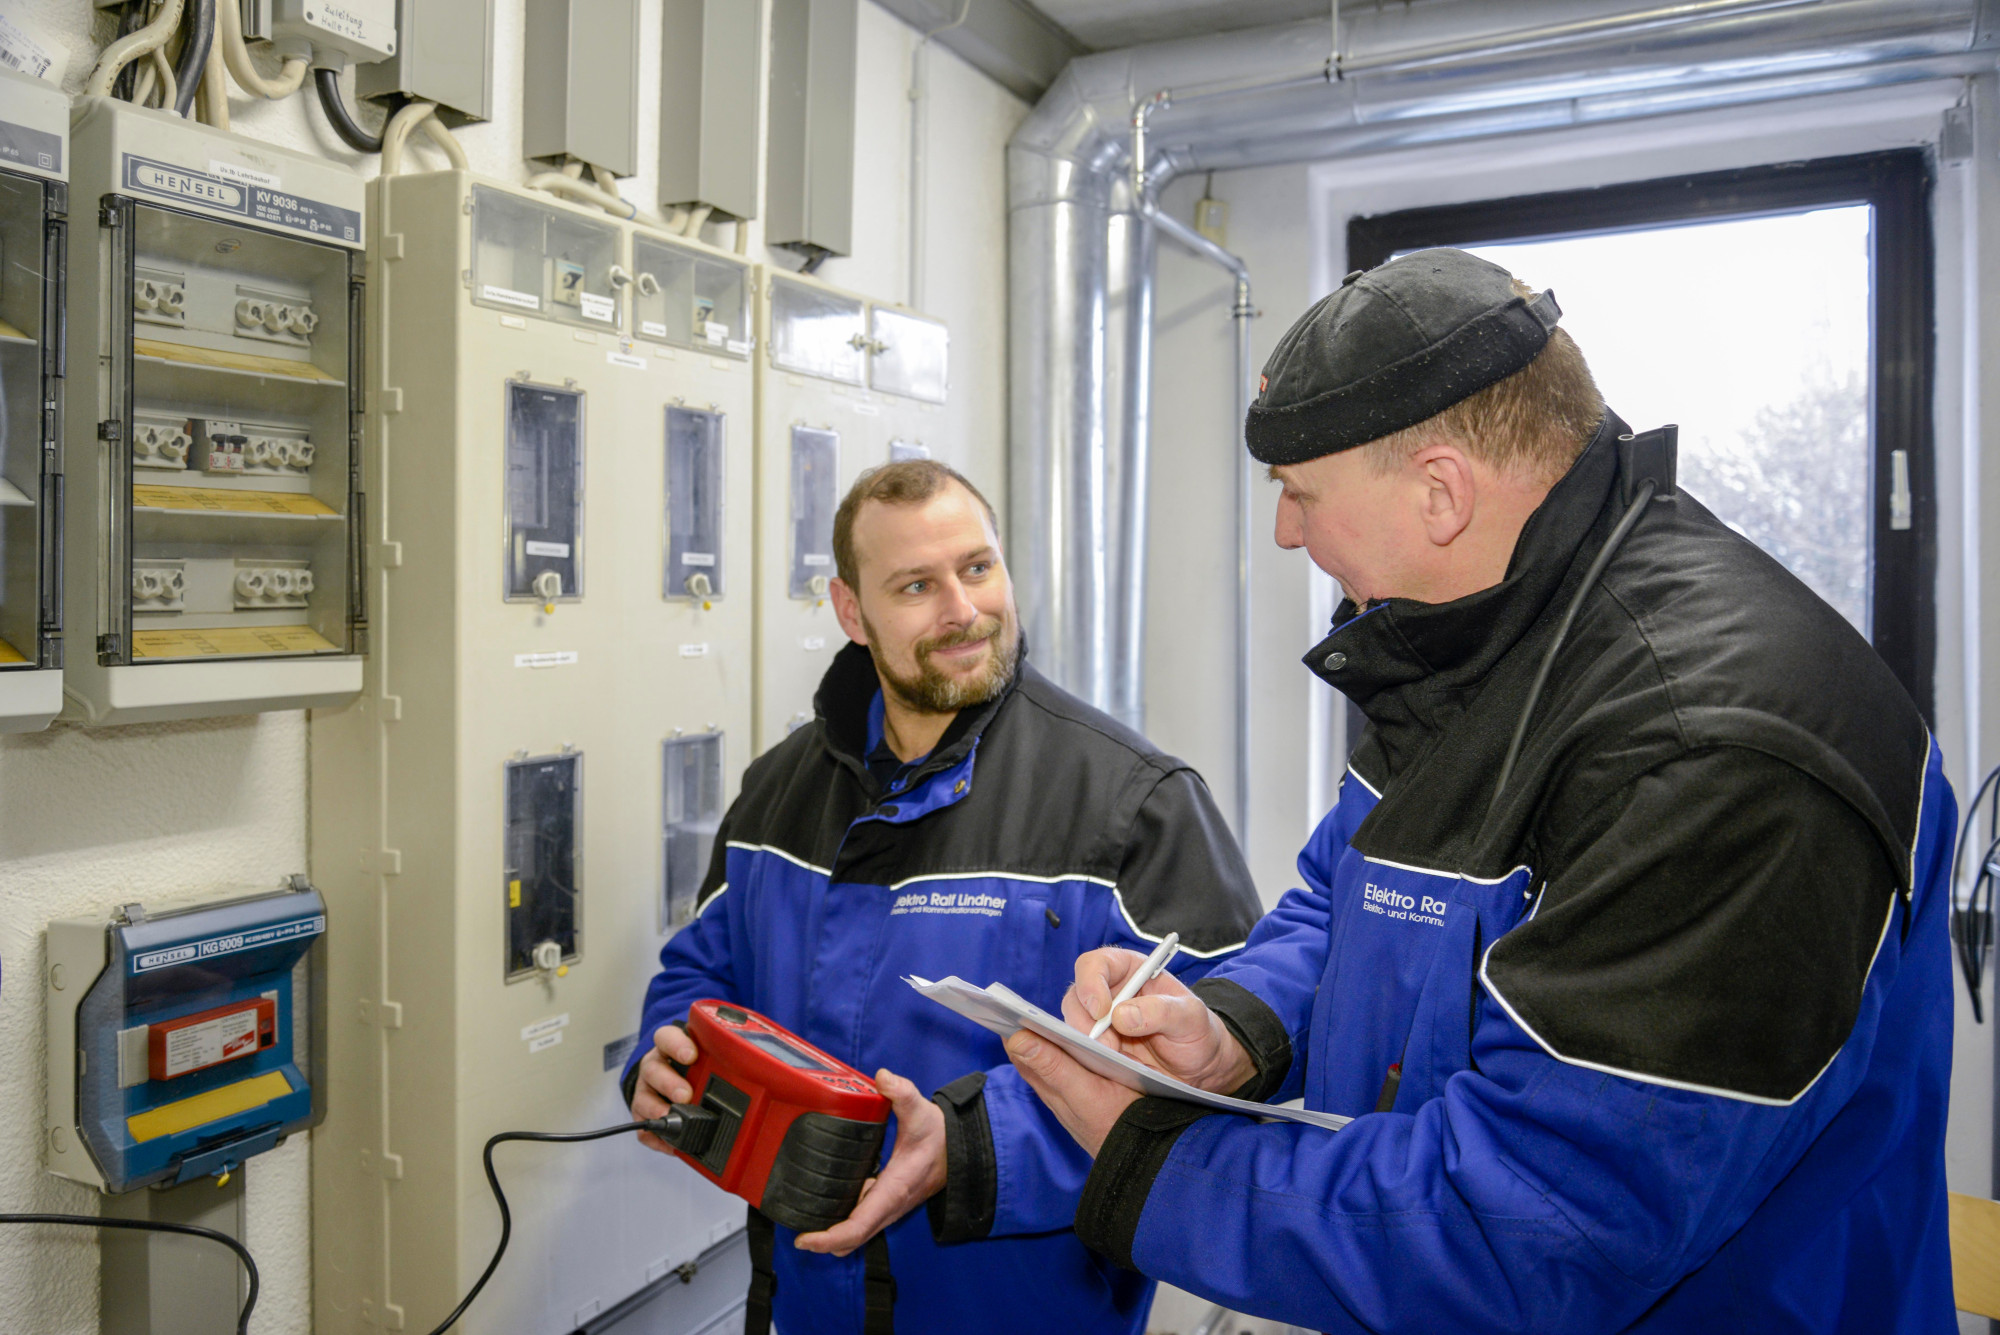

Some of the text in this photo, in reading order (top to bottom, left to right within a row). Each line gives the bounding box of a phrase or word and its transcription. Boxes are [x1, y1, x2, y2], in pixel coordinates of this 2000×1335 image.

[324, 3, 363, 29] Zuleitung
[154, 172, 225, 200] HENSEL
[256, 190, 271, 204] KV
[272, 194, 298, 211] 9036
[930, 891, 956, 907] Ralf
[957, 893, 1007, 909] Lindner
[1363, 901, 1386, 915] Elektro-
[1387, 909, 1408, 920] und
[1364, 882, 1447, 916] Elektro Ra
[148, 950, 187, 964] HENSEL
[202, 941, 219, 955] KG
[219, 935, 244, 951] 9009
